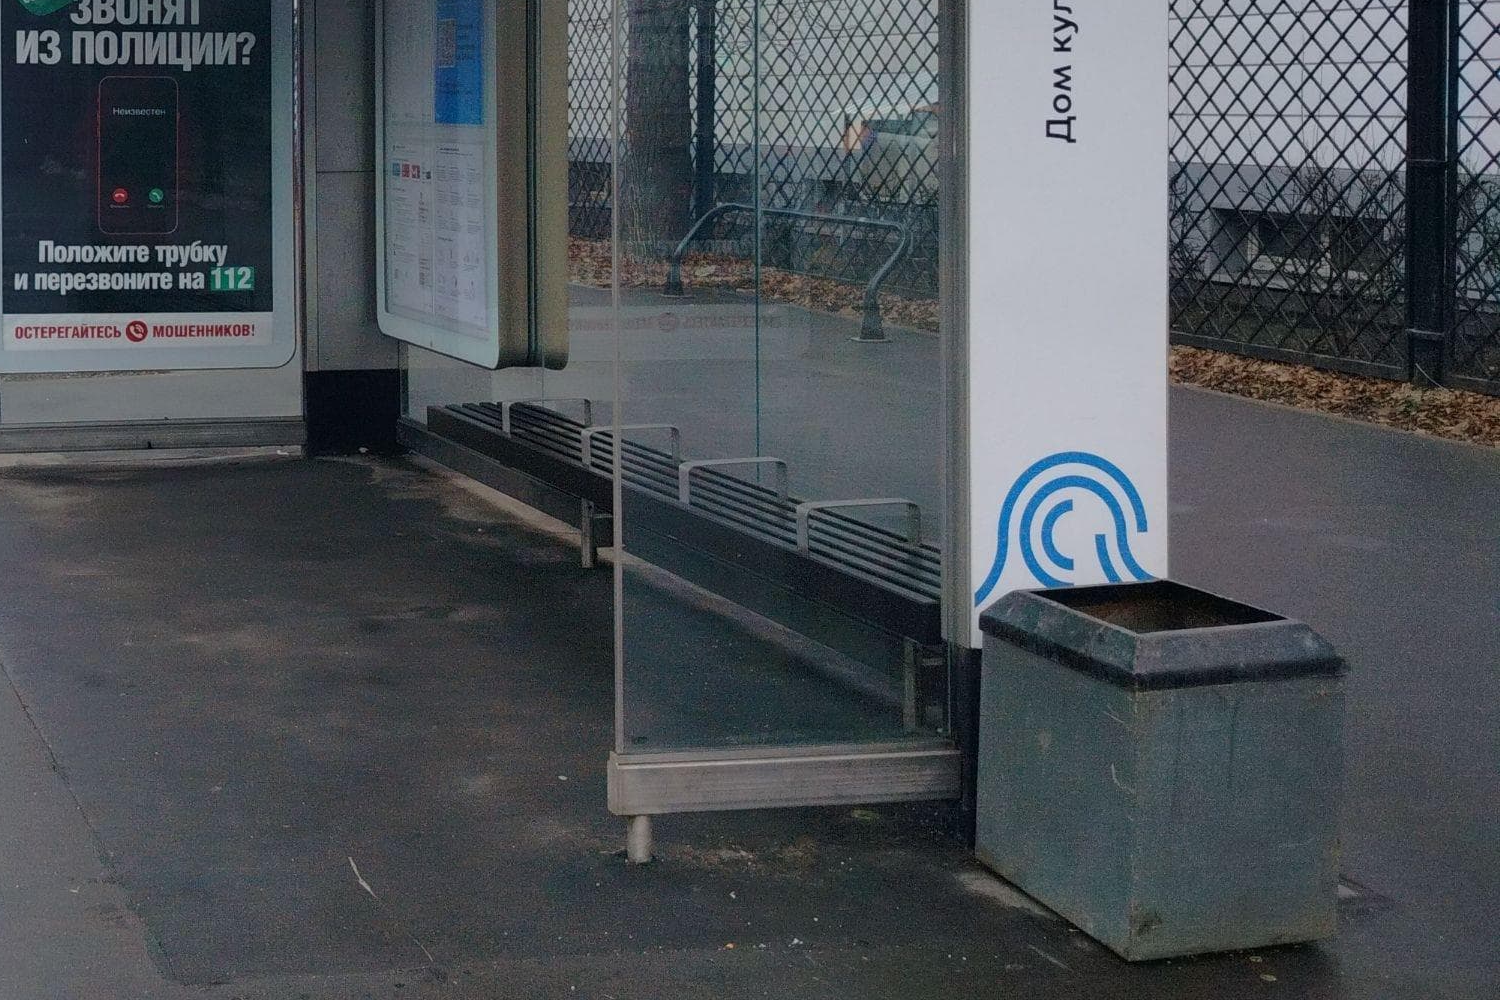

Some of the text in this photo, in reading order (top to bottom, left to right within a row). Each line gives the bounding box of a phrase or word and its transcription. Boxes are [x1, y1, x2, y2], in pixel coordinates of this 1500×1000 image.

[15, 29, 257, 72] ИЗ ПОЛИЦИИ?
[112, 106, 166, 116] Неизвестен
[1046, 64, 1077, 144] Дом
[38, 240, 228, 267] Положите трубку
[14, 266, 252, 295] и перезвоните на 112
[14, 323, 256, 339] ОСТЕРЕГАЙТЕСЬ МОШЕННИКОВ!
